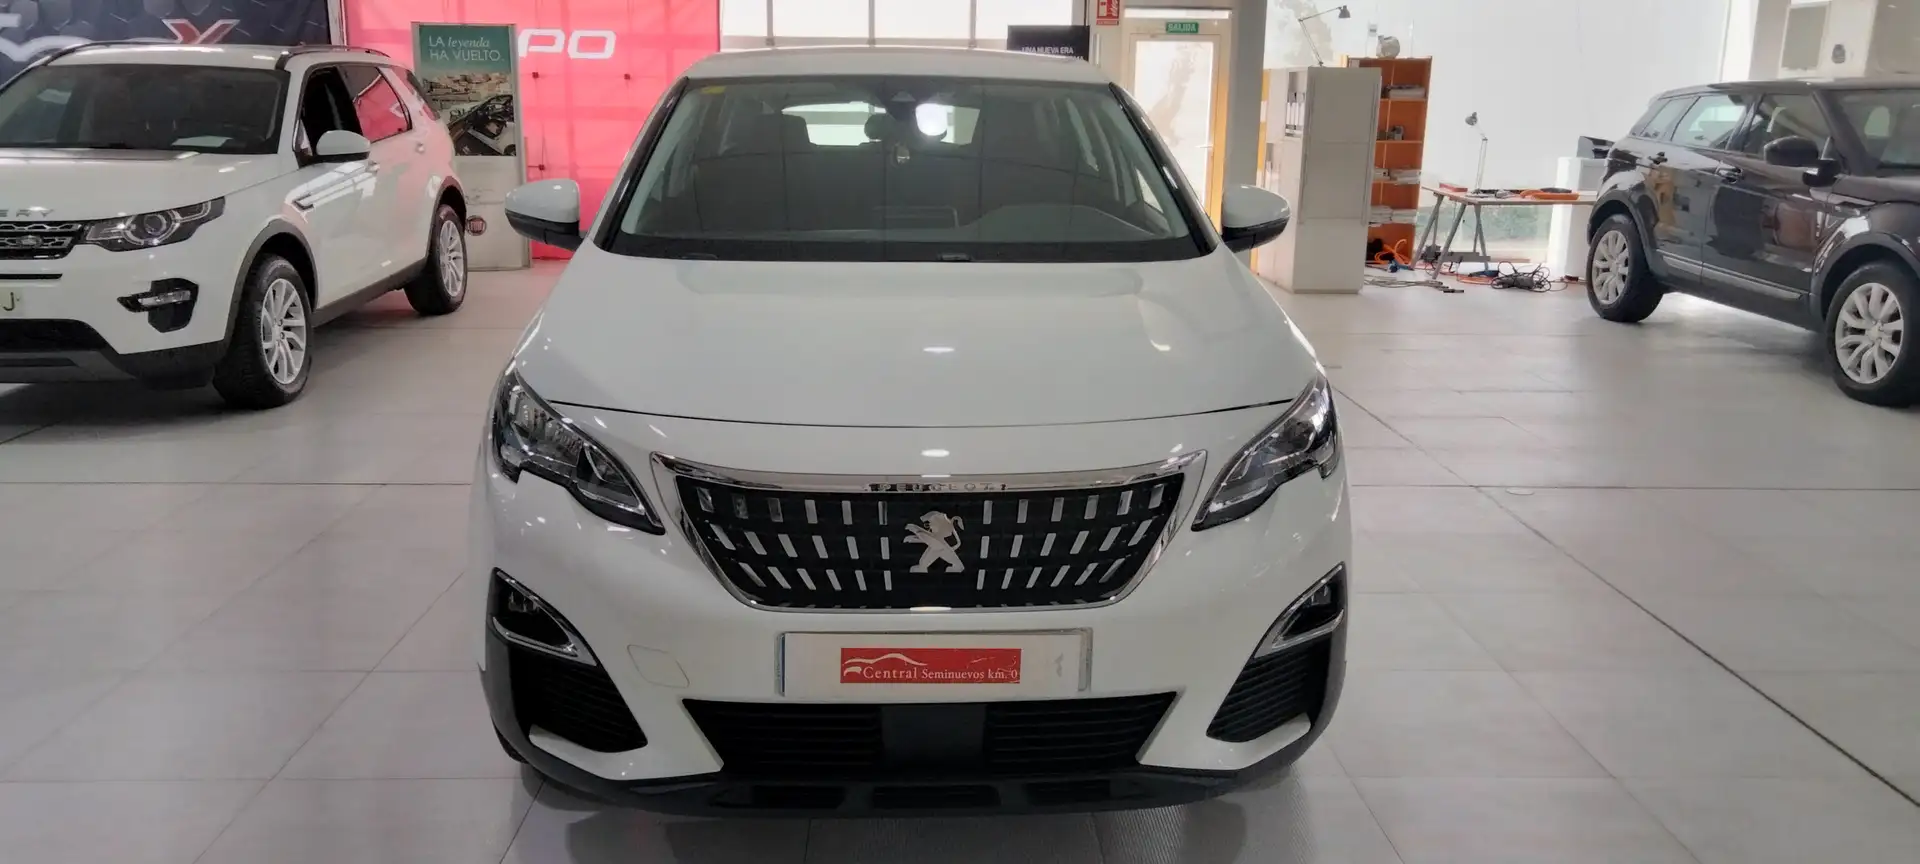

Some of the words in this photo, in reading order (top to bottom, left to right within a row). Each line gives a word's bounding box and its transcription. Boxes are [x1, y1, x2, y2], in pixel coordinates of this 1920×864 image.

[1168, 23, 1197, 32] SALIDA
[428, 36, 445, 47] LA
[448, 36, 490, 49] leyenda
[429, 50, 449, 61] HA
[1037, 46, 1059, 54] NUEVA
[863, 666, 918, 679] Central
[921, 668, 985, 679] Seminuevos
[988, 668, 1008, 679] km.
[1011, 668, 1018, 679] 0
